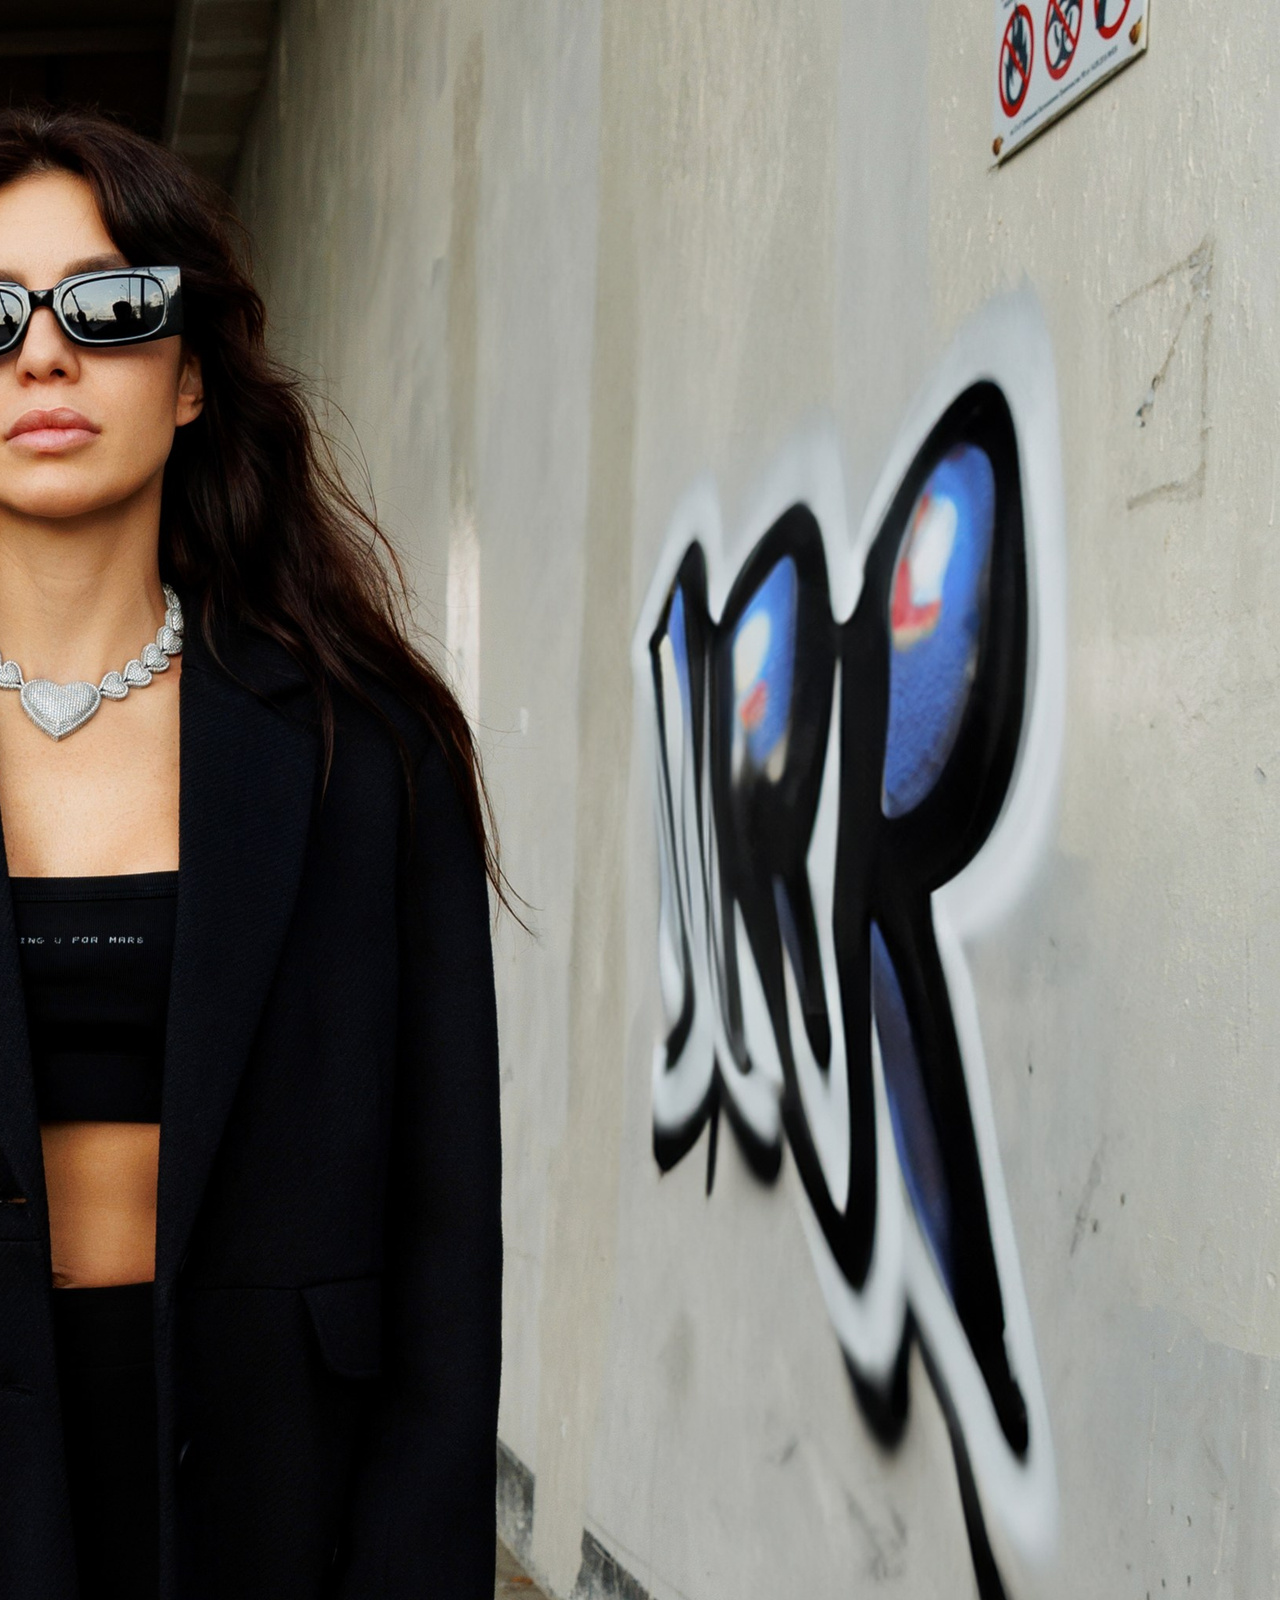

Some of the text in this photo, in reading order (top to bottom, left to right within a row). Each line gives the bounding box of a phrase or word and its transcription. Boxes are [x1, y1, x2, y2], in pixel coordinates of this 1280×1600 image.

[20, 936, 144, 945] ING U FOR MARS
